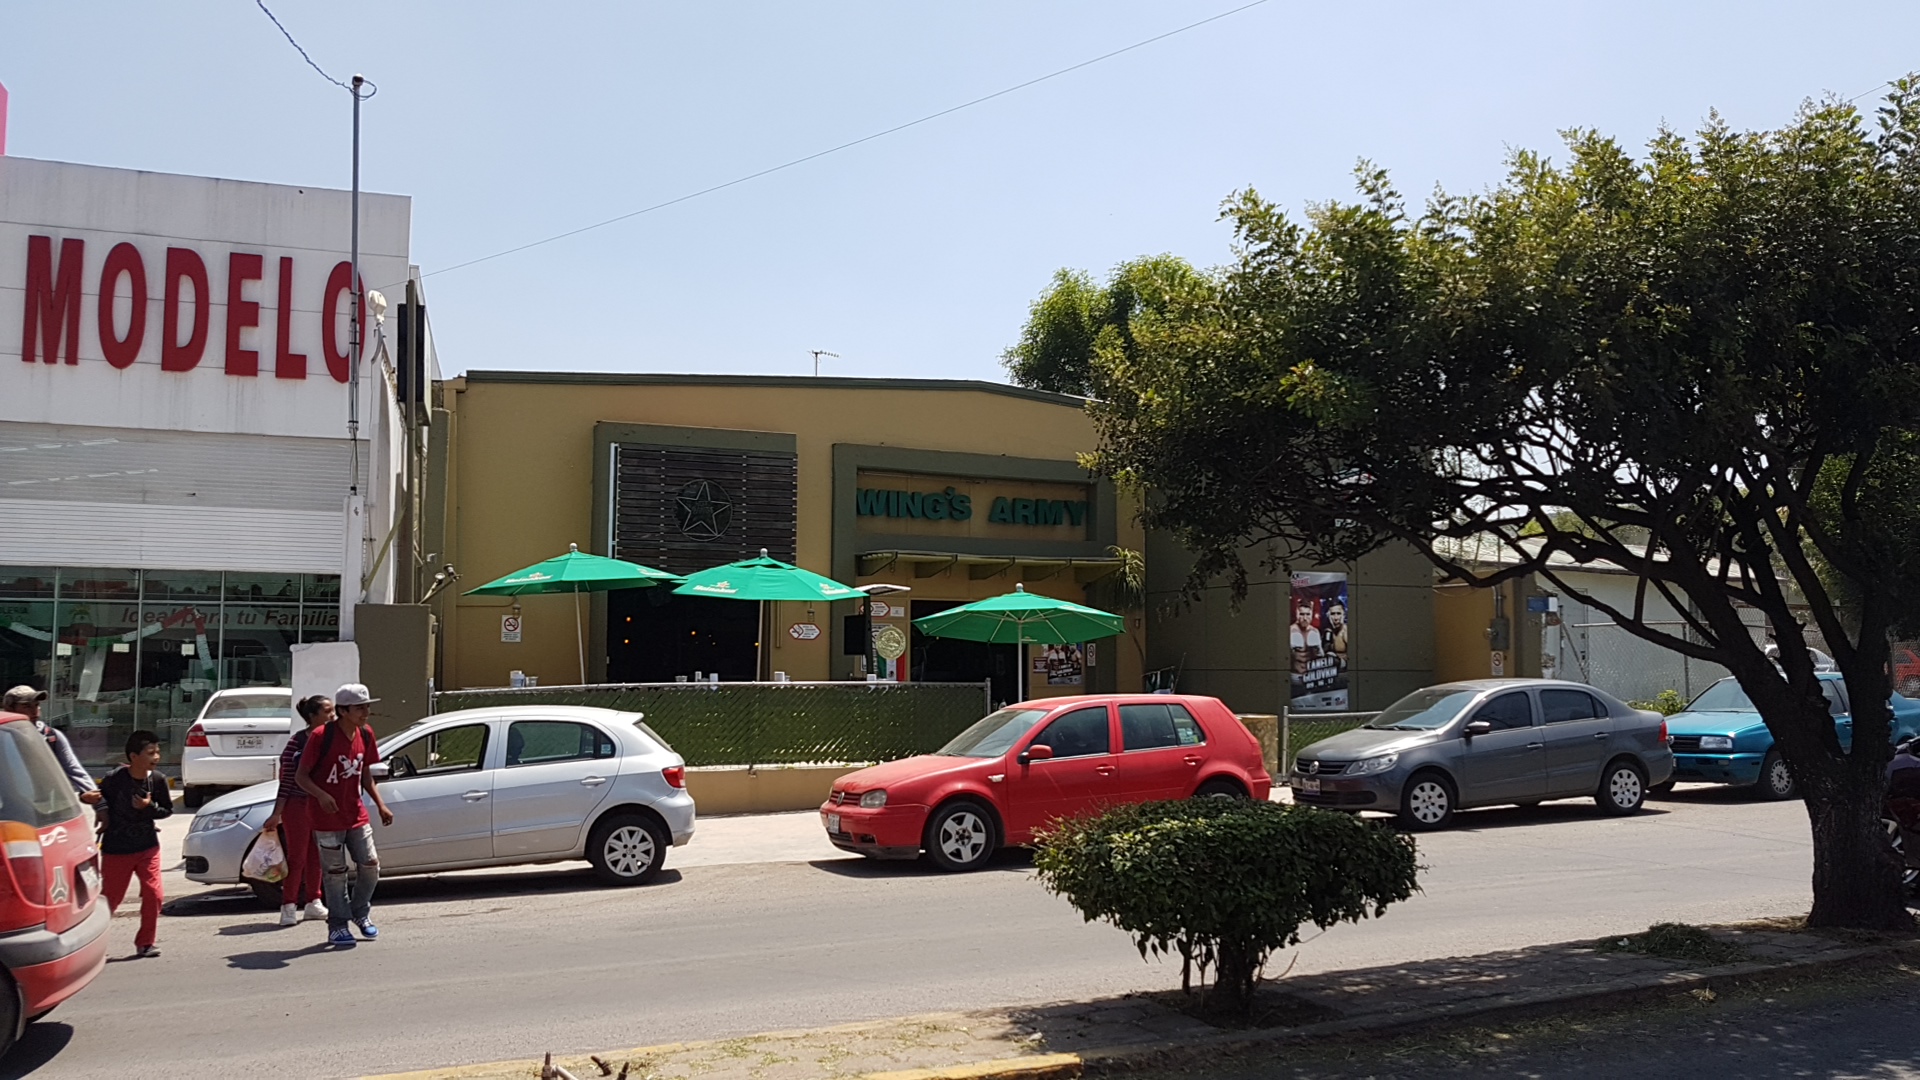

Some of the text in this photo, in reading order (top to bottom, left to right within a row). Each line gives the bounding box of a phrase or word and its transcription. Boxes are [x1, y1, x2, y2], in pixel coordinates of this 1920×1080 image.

[22, 234, 366, 384] MODELO
[856, 486, 1087, 526] WING'S ARMY
[237, 609, 257, 625] tu
[264, 609, 338, 626] Familia
[1307, 656, 1334, 670] CANELO
[1303, 666, 1337, 683] GOLOVKIN
